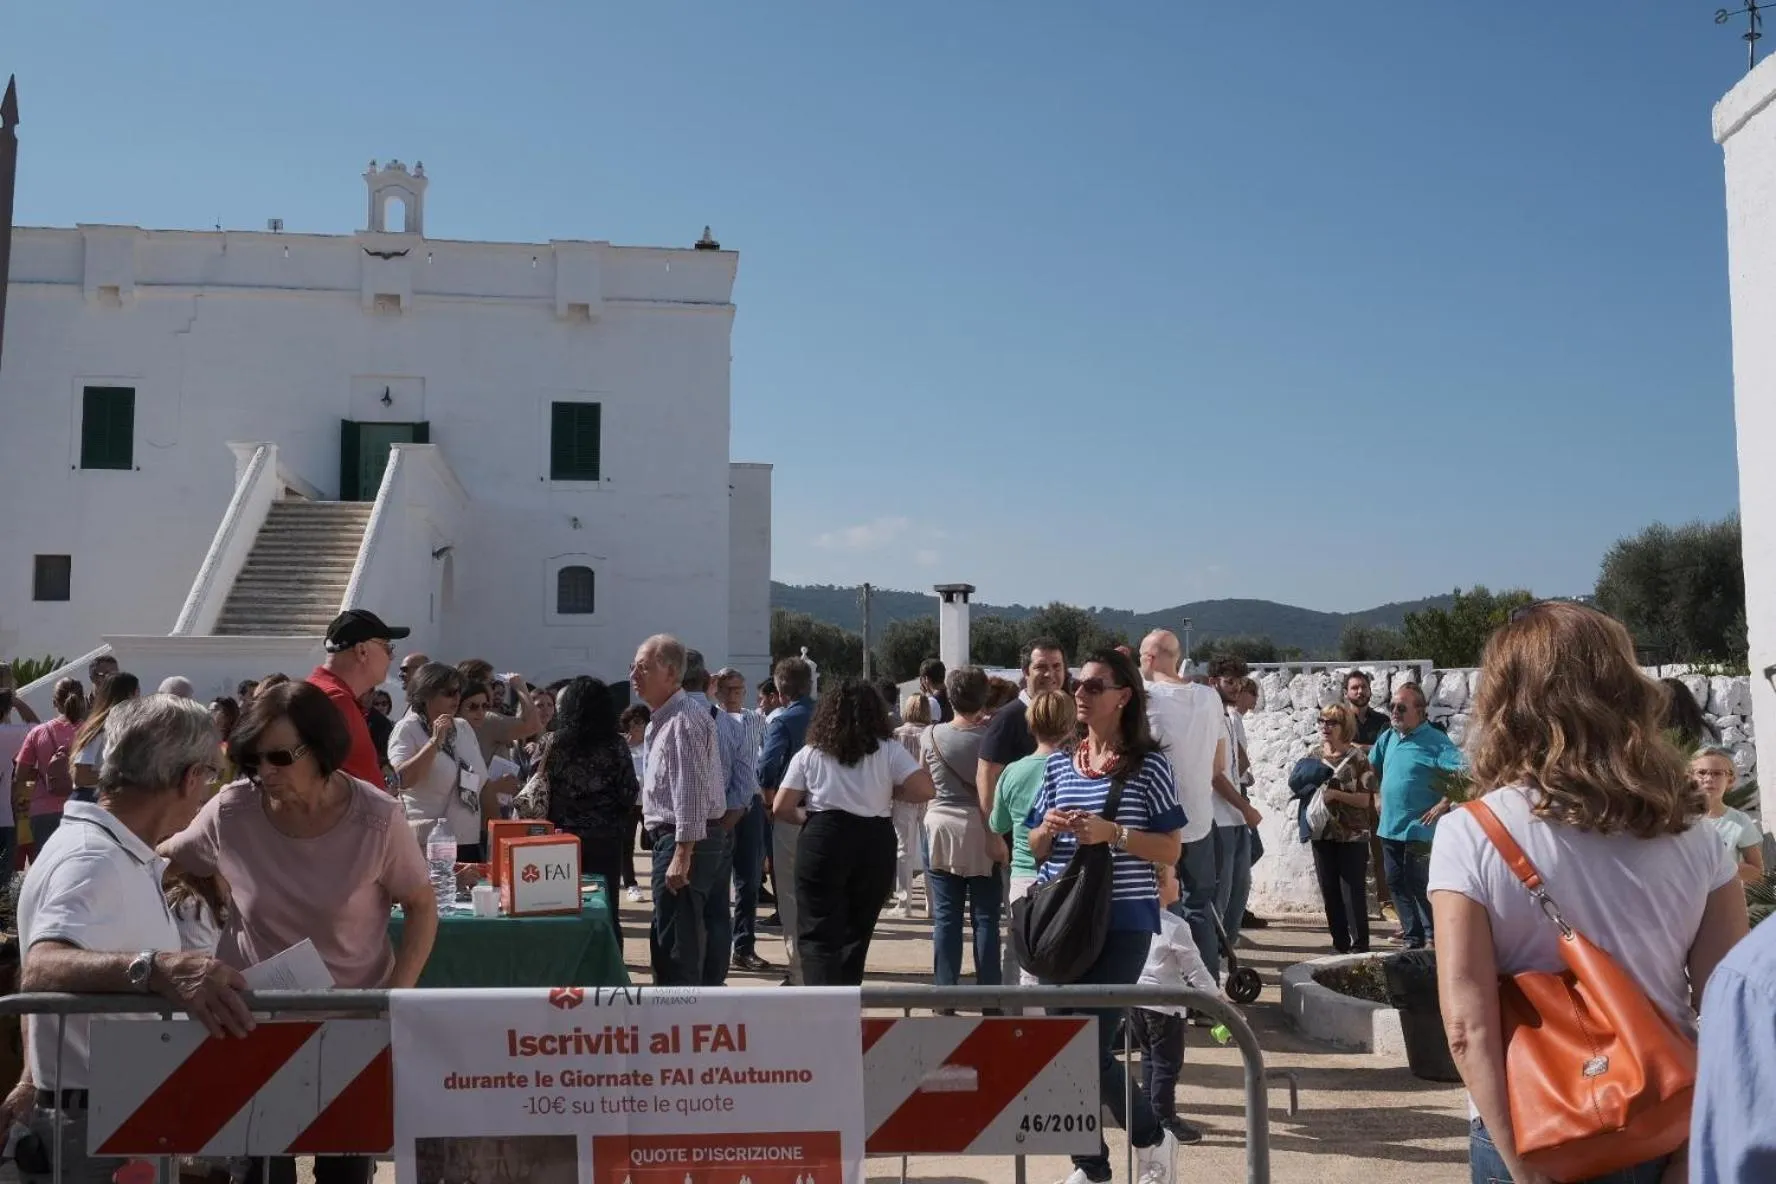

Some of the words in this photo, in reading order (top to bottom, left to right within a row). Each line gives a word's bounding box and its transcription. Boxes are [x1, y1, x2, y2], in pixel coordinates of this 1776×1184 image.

[545, 863, 570, 881] FAI
[507, 1025, 639, 1057] Iscriviti
[650, 1025, 681, 1055] al
[692, 1023, 747, 1053] FAI
[443, 1071, 529, 1090] durante
[535, 1070, 554, 1088] le
[559, 1069, 654, 1088] Giornate
[660, 1068, 694, 1086] FAI
[700, 1066, 813, 1085] d'Autunno
[522, 1096, 566, 1115] -10€
[572, 1099, 595, 1114] su
[600, 1096, 649, 1114] tutte
[654, 1095, 671, 1113] le
[676, 1093, 735, 1117] quote
[1019, 1114, 1097, 1132] 46/2010
[630, 1148, 688, 1166] QUOTE
[692, 1146, 805, 1163] D'ISCRIZIONE
